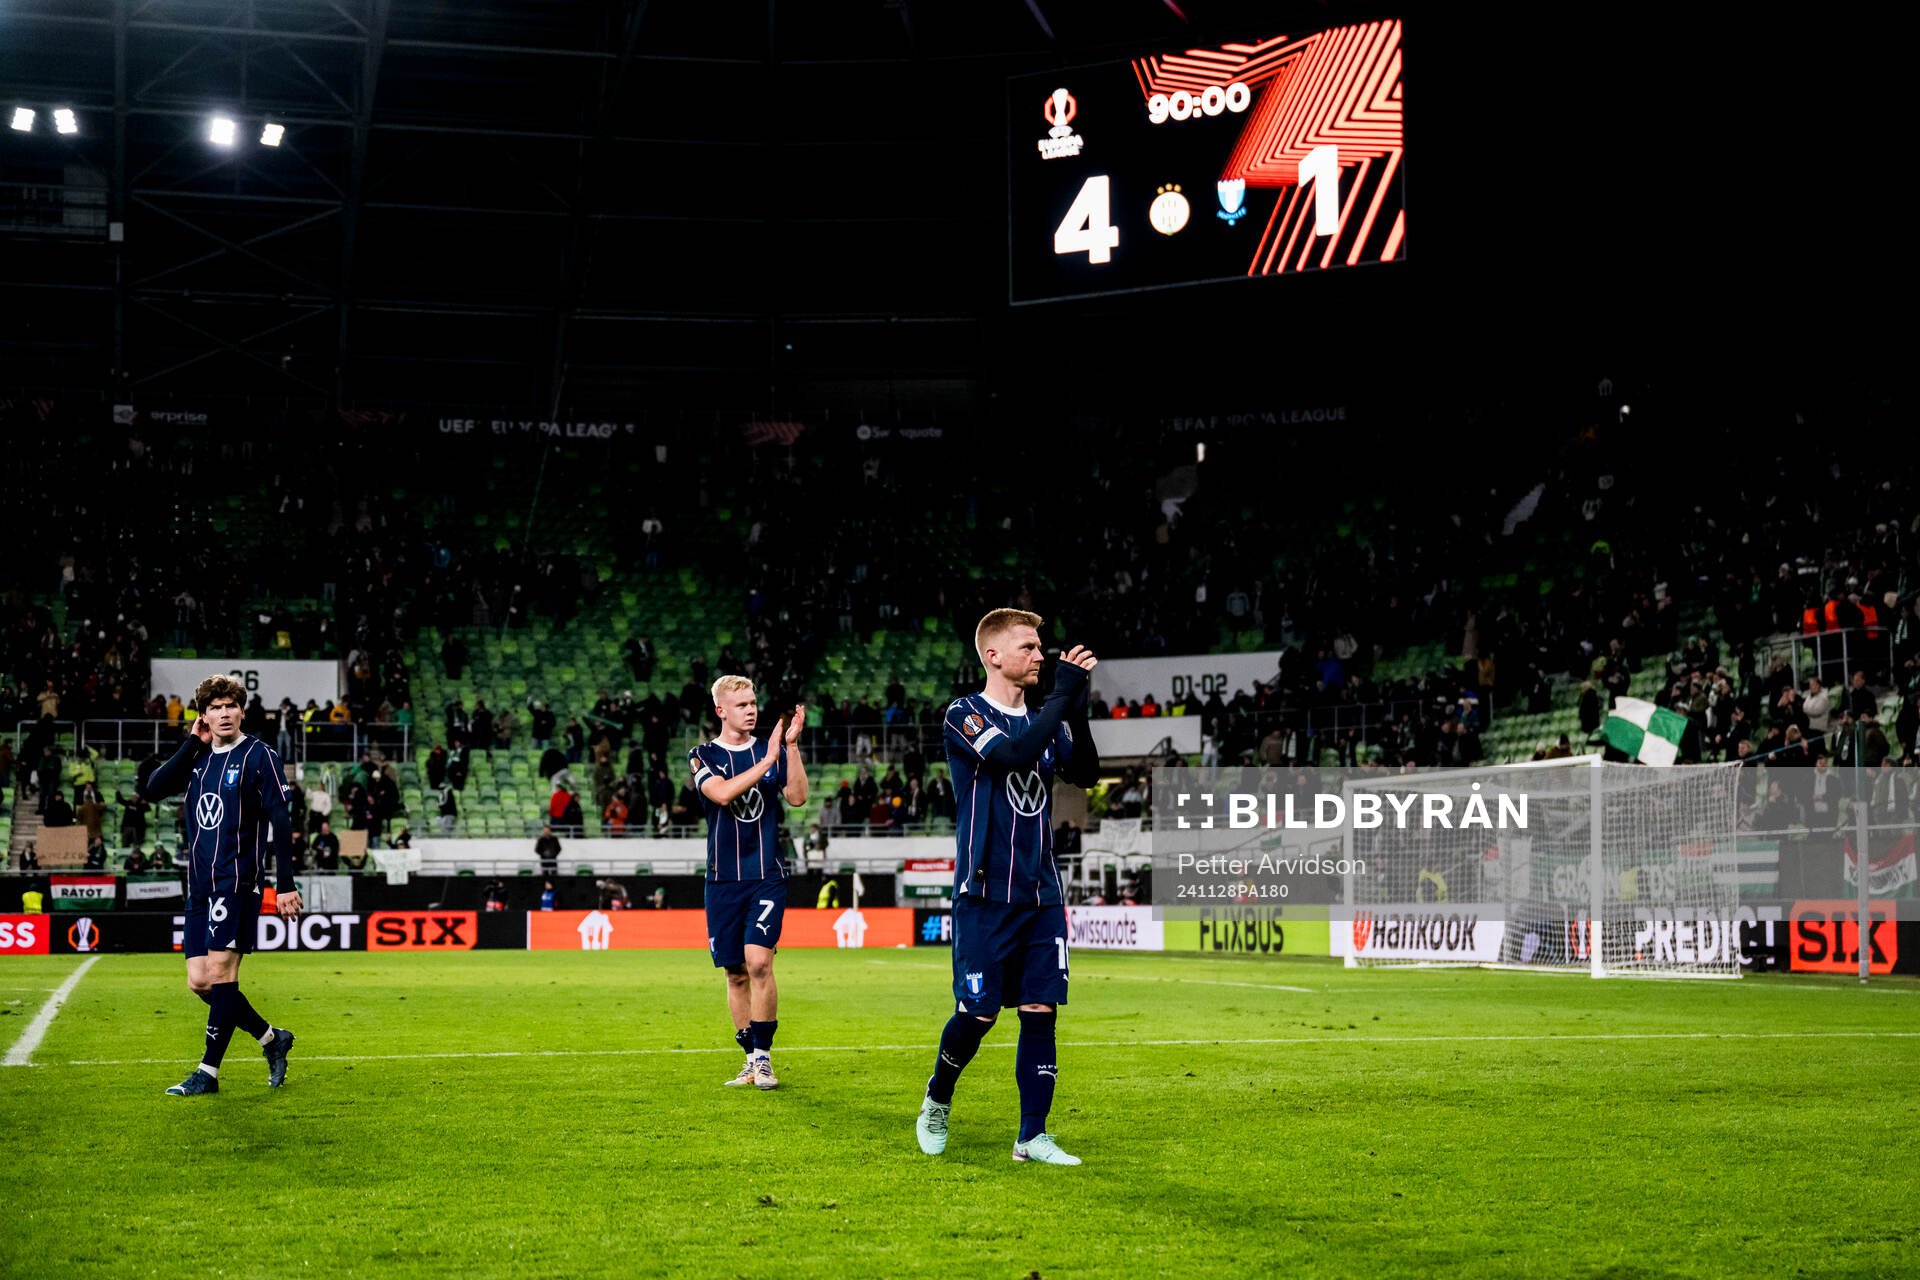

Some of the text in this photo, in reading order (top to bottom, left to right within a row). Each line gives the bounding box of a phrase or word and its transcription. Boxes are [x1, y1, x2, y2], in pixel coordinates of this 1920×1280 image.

[1148, 82, 1251, 124] 90:00
[1299, 144, 1339, 236] 1
[1054, 174, 1119, 264] 4
[1172, 673, 1228, 699] 01-02
[757, 900, 775, 922] 7
[1070, 909, 1137, 948] Swissquote
[374, 917, 470, 946] SIX
[1635, 905, 1889, 964] PREDICT SIX
